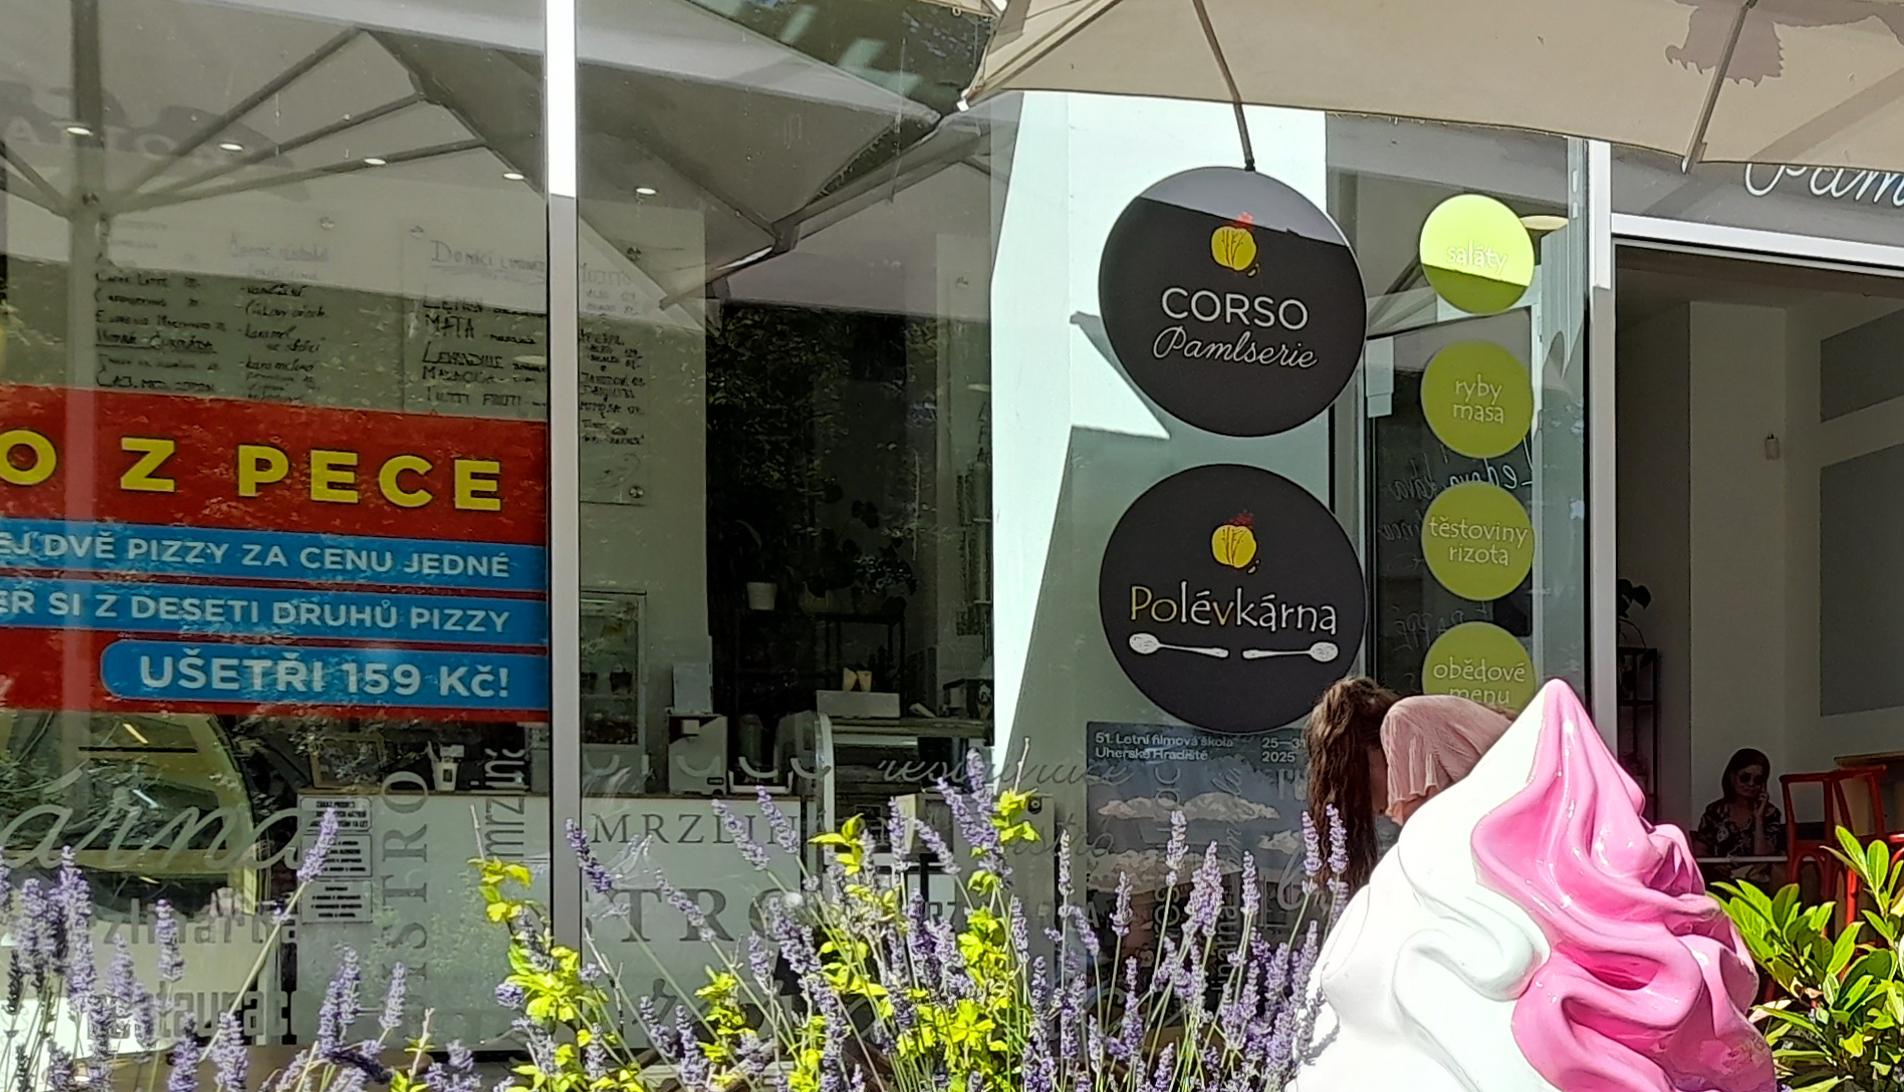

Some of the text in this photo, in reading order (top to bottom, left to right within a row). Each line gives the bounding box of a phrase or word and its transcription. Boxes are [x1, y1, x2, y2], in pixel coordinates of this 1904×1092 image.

[1446, 240, 1508, 275] saláty
[1162, 286, 1309, 330] CORSO
[1152, 325, 1318, 368] Pamlserie
[1454, 376, 1503, 408] ryby
[1453, 403, 1505, 424] masa
[119, 438, 176, 492] Z
[238, 444, 503, 512] PECE
[1428, 517, 1528, 549] těstoviny
[44, 531, 115, 560] DVĚ
[127, 540, 226, 566] PIZZY
[242, 545, 288, 568] ZA
[300, 546, 393, 573] CENU
[404, 550, 510, 579] JEDNÉ
[1448, 540, 1509, 567] rizota
[49, 592, 82, 617] SI
[94, 594, 118, 618] Z
[131, 595, 260, 624] DESETI
[272, 598, 398, 630] DRUHŮ
[410, 610, 511, 634] PIZZY
[1130, 580, 1337, 634] Polévkárna
[140, 648, 509, 699] UŠETŘI 159 Kč!
[1433, 659, 1526, 684] obědové
[1448, 687, 1510, 705] menu
[1262, 751, 1295, 763] 2025
[380, 770, 428, 981] ISTRO
